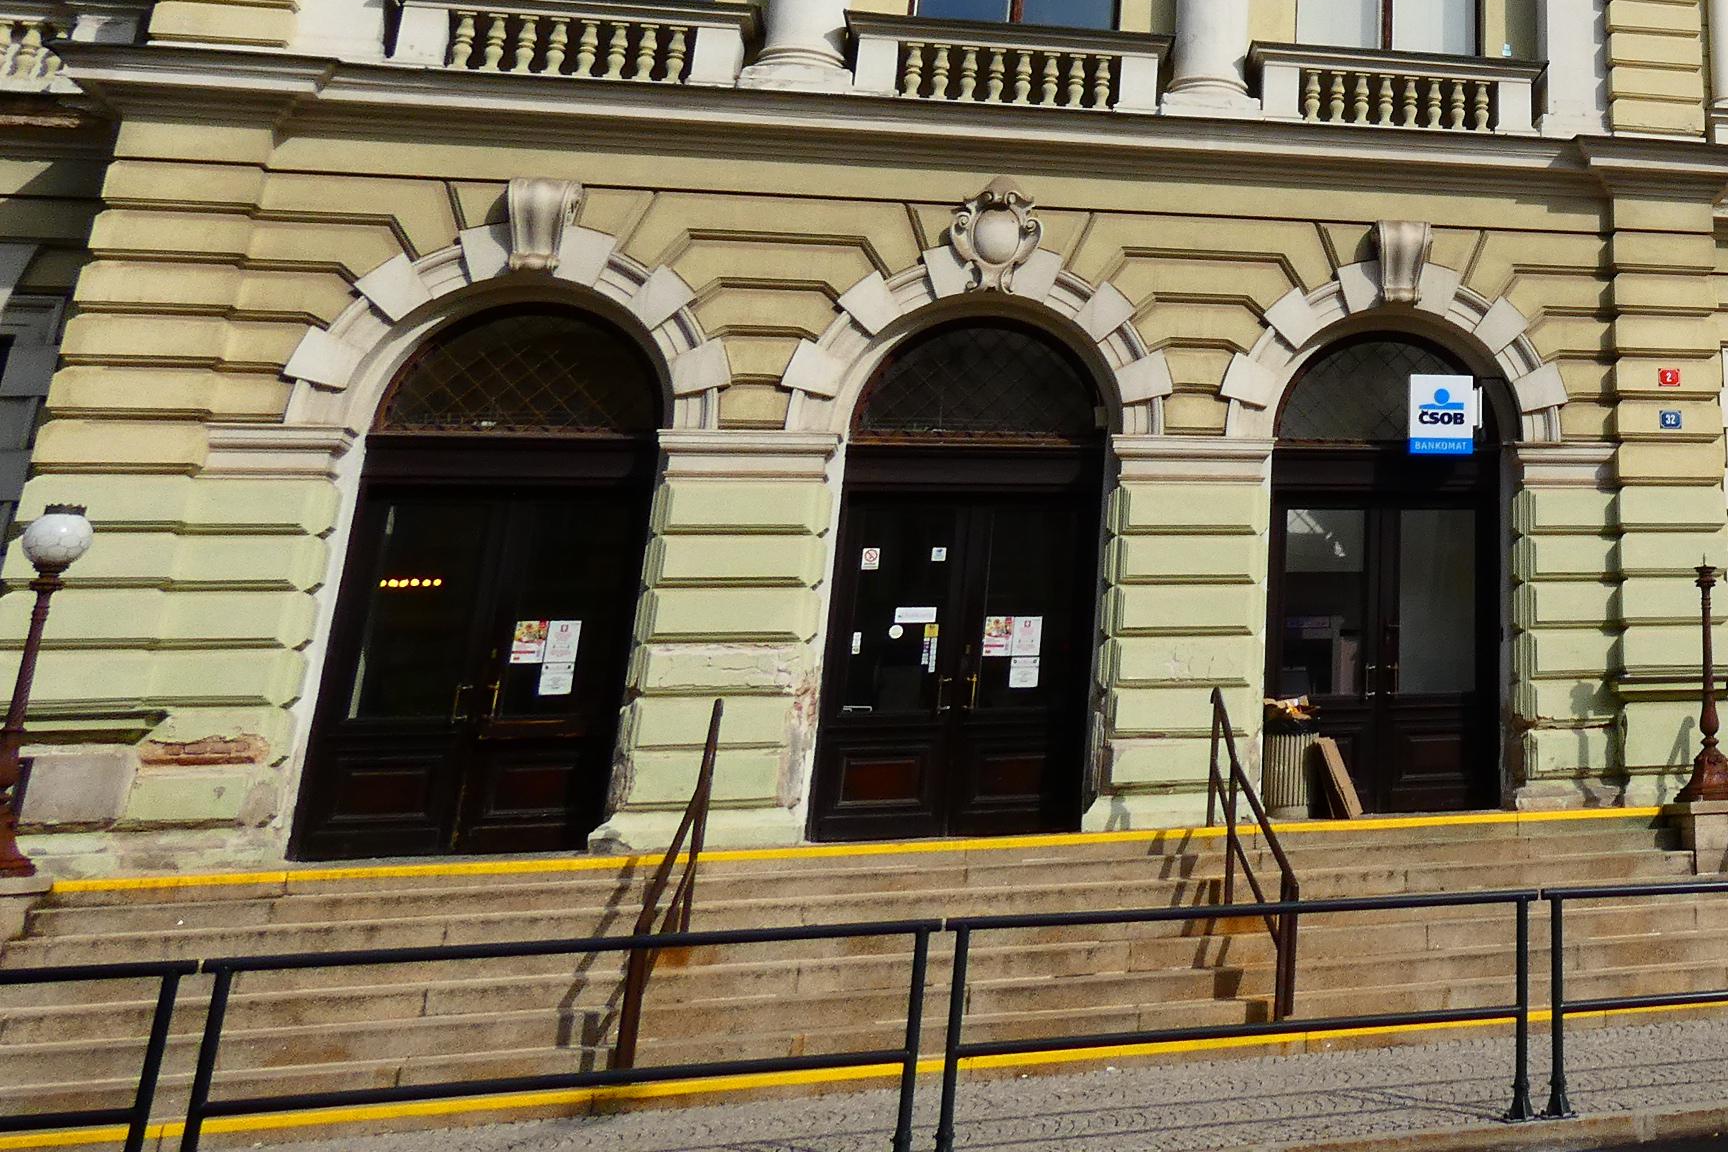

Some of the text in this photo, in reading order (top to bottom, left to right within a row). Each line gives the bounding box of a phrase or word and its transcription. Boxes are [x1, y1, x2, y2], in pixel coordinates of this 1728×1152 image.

[1665, 371, 1673, 383] 2
[1418, 409, 1465, 425] ČSOB
[1665, 413, 1676, 425] 32
[1414, 440, 1467, 451] BANKOMAT
